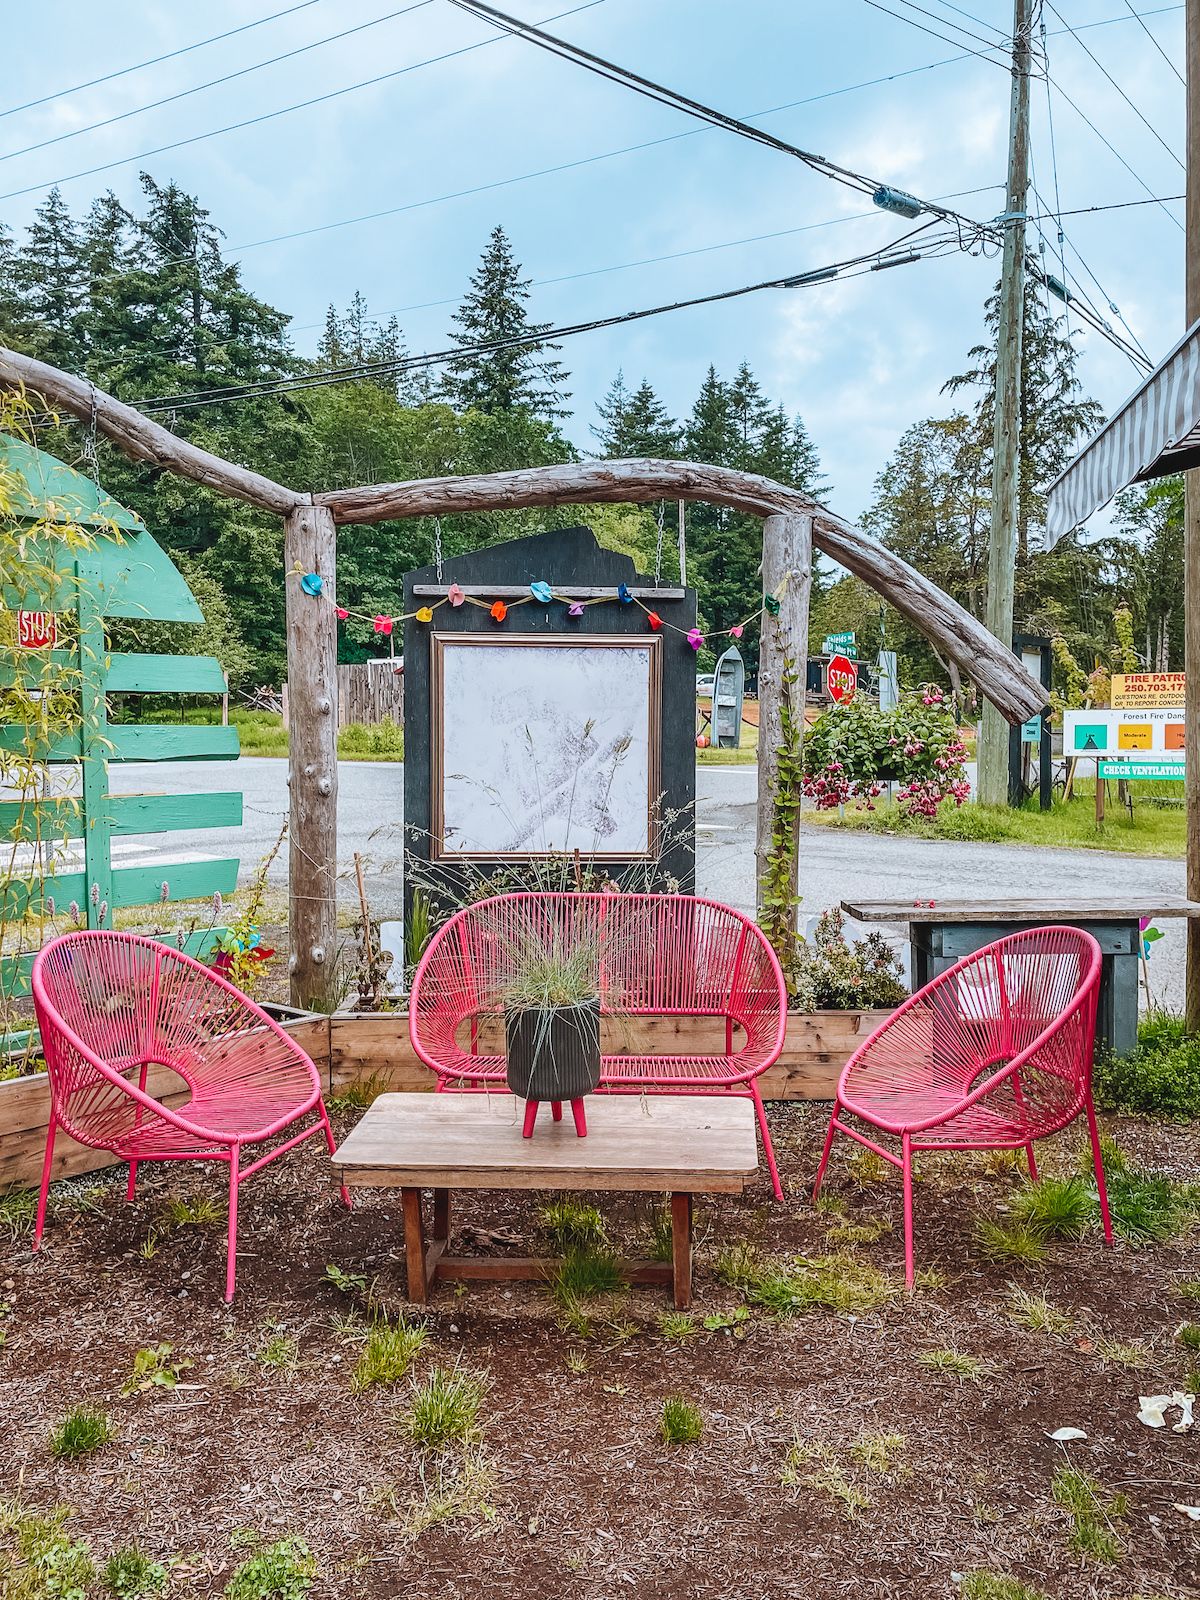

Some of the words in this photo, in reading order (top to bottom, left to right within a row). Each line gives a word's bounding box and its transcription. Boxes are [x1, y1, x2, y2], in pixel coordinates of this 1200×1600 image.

[830, 669, 854, 691] STOP
[1124, 675, 1150, 683] FIRE
[1124, 683, 1186, 692] 250.703.17
[1103, 765, 1130, 775] CHECK
[1132, 765, 1185, 776] VENTILATION
